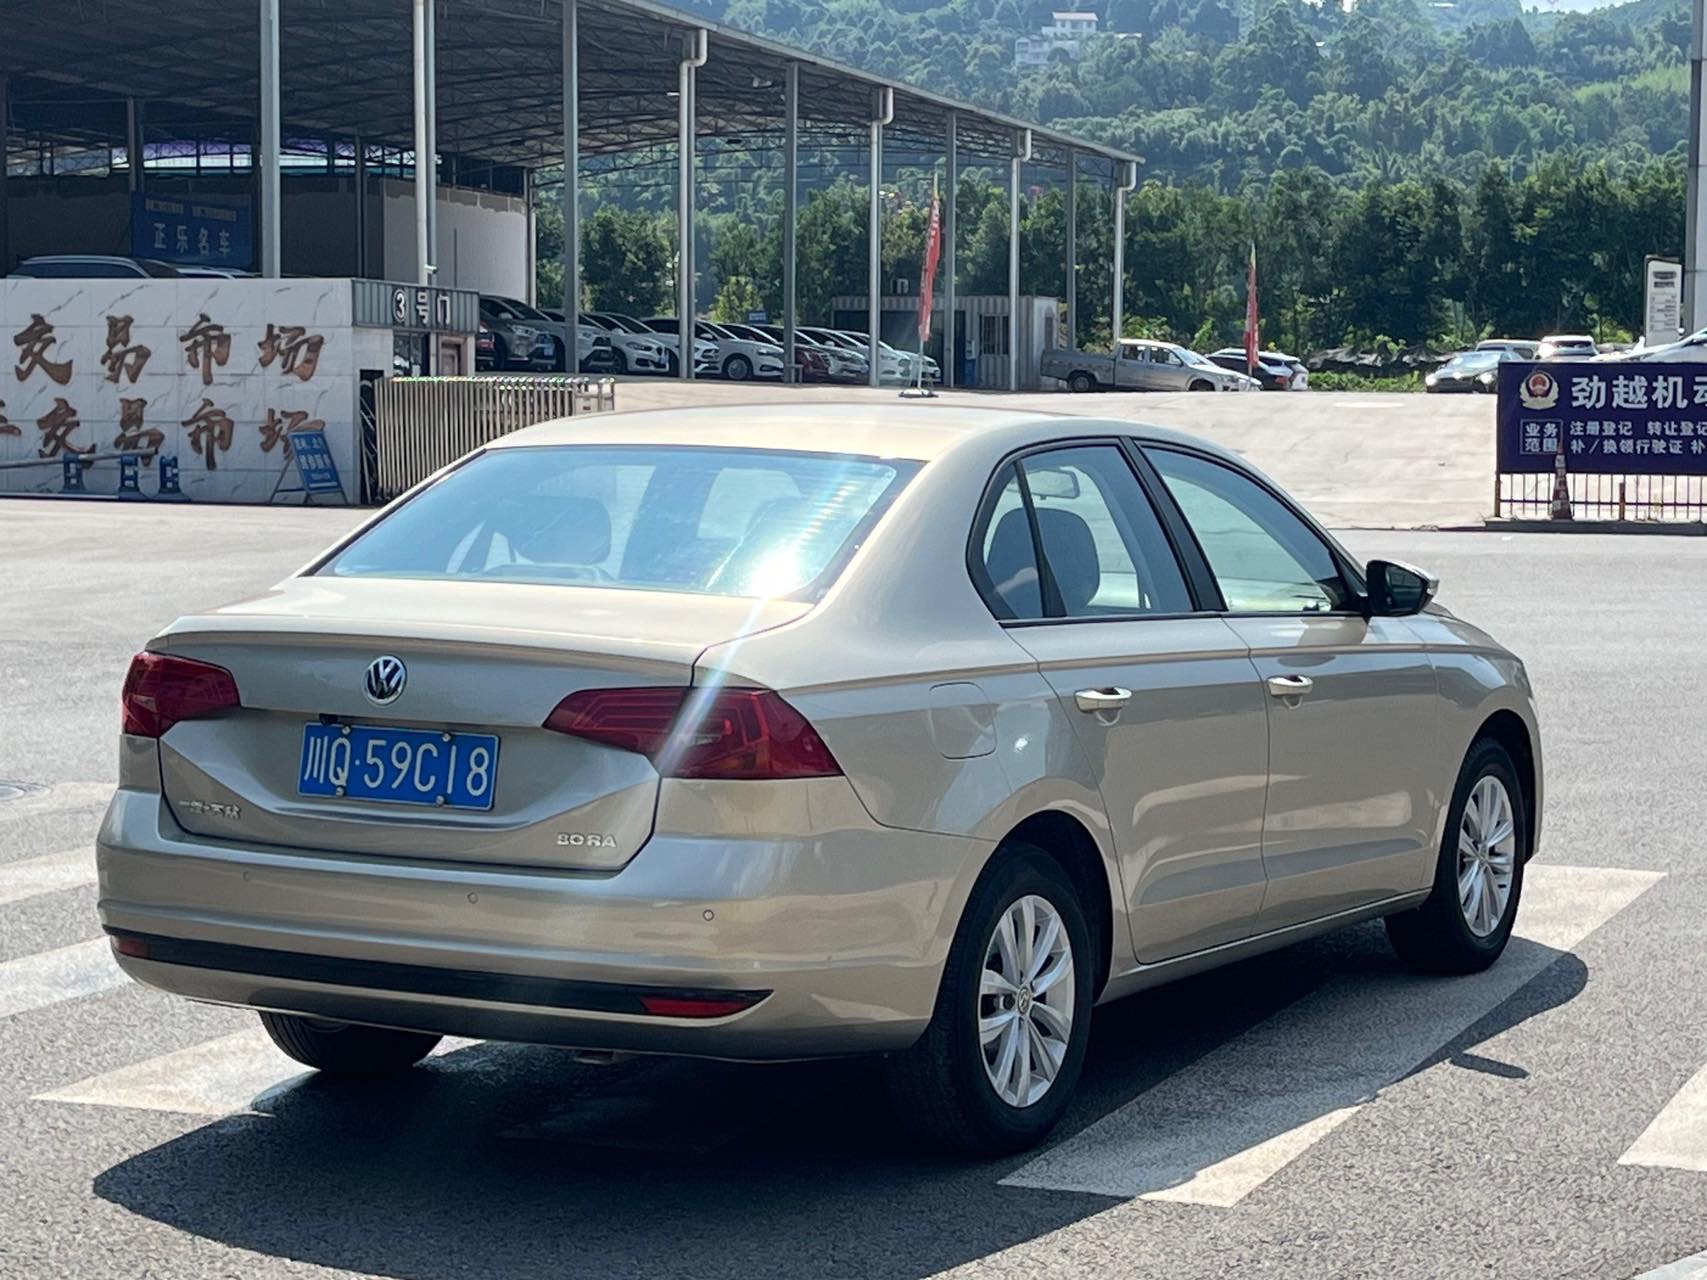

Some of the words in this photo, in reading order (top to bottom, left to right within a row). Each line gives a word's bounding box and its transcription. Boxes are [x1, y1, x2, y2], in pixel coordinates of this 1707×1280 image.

[14, 313, 325, 387] 交易市场
[1525, 422, 1558, 437] 业务
[1570, 421, 1633, 436] 注册登记
[556, 833, 617, 848] BORA
